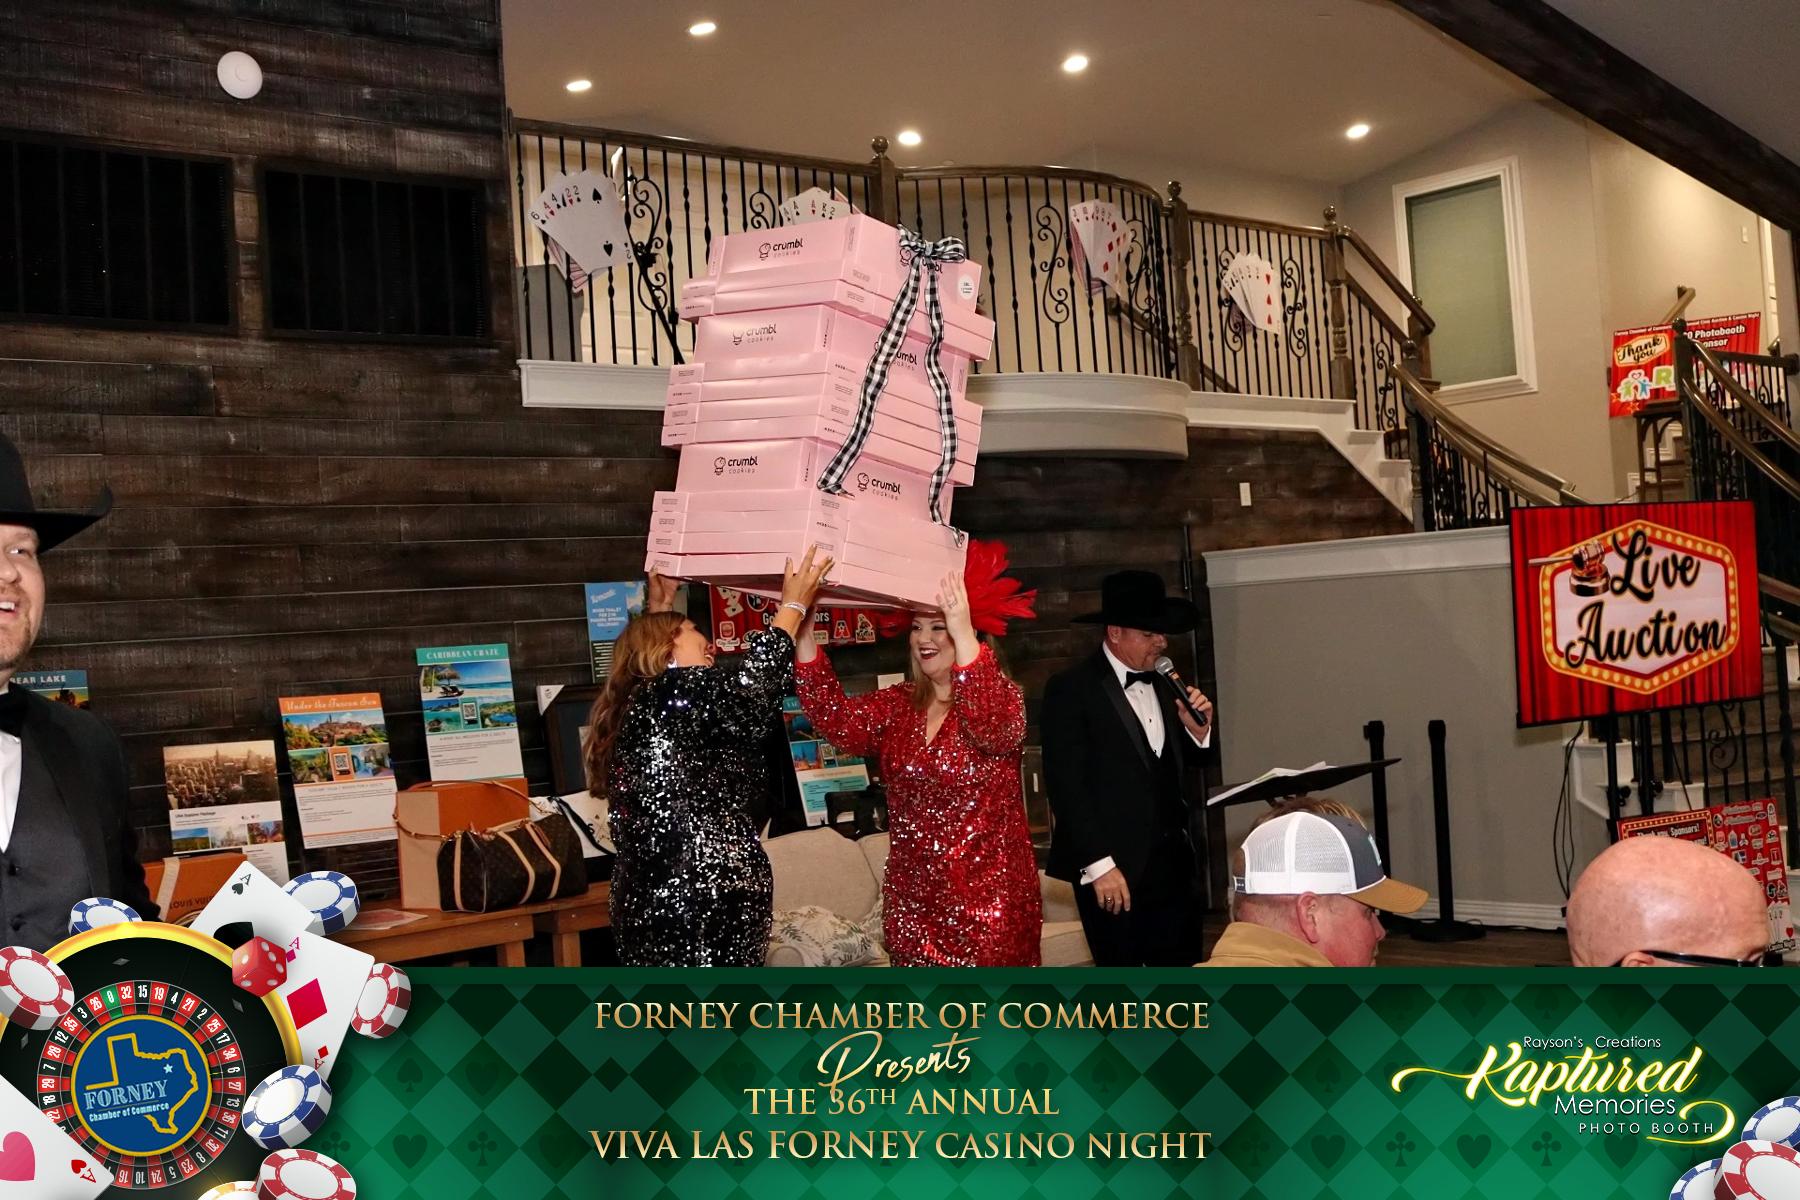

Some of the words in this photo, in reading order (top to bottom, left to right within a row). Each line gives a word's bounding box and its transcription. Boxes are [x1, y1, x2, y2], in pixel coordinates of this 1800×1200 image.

[773, 238, 803, 251] crumbl
[746, 324, 777, 336] crumbl
[1694, 324, 1746, 339] Photobooth
[1616, 335, 1662, 361] Thank
[1634, 348, 1656, 363] you
[727, 456, 758, 466] crumbl
[871, 478, 901, 495] crumbl
[1610, 530, 1700, 601] Live
[1565, 600, 1727, 668] Auction
[40, 675, 66, 683] LAKE
[287, 702, 313, 711] Under
[314, 701, 326, 709] the
